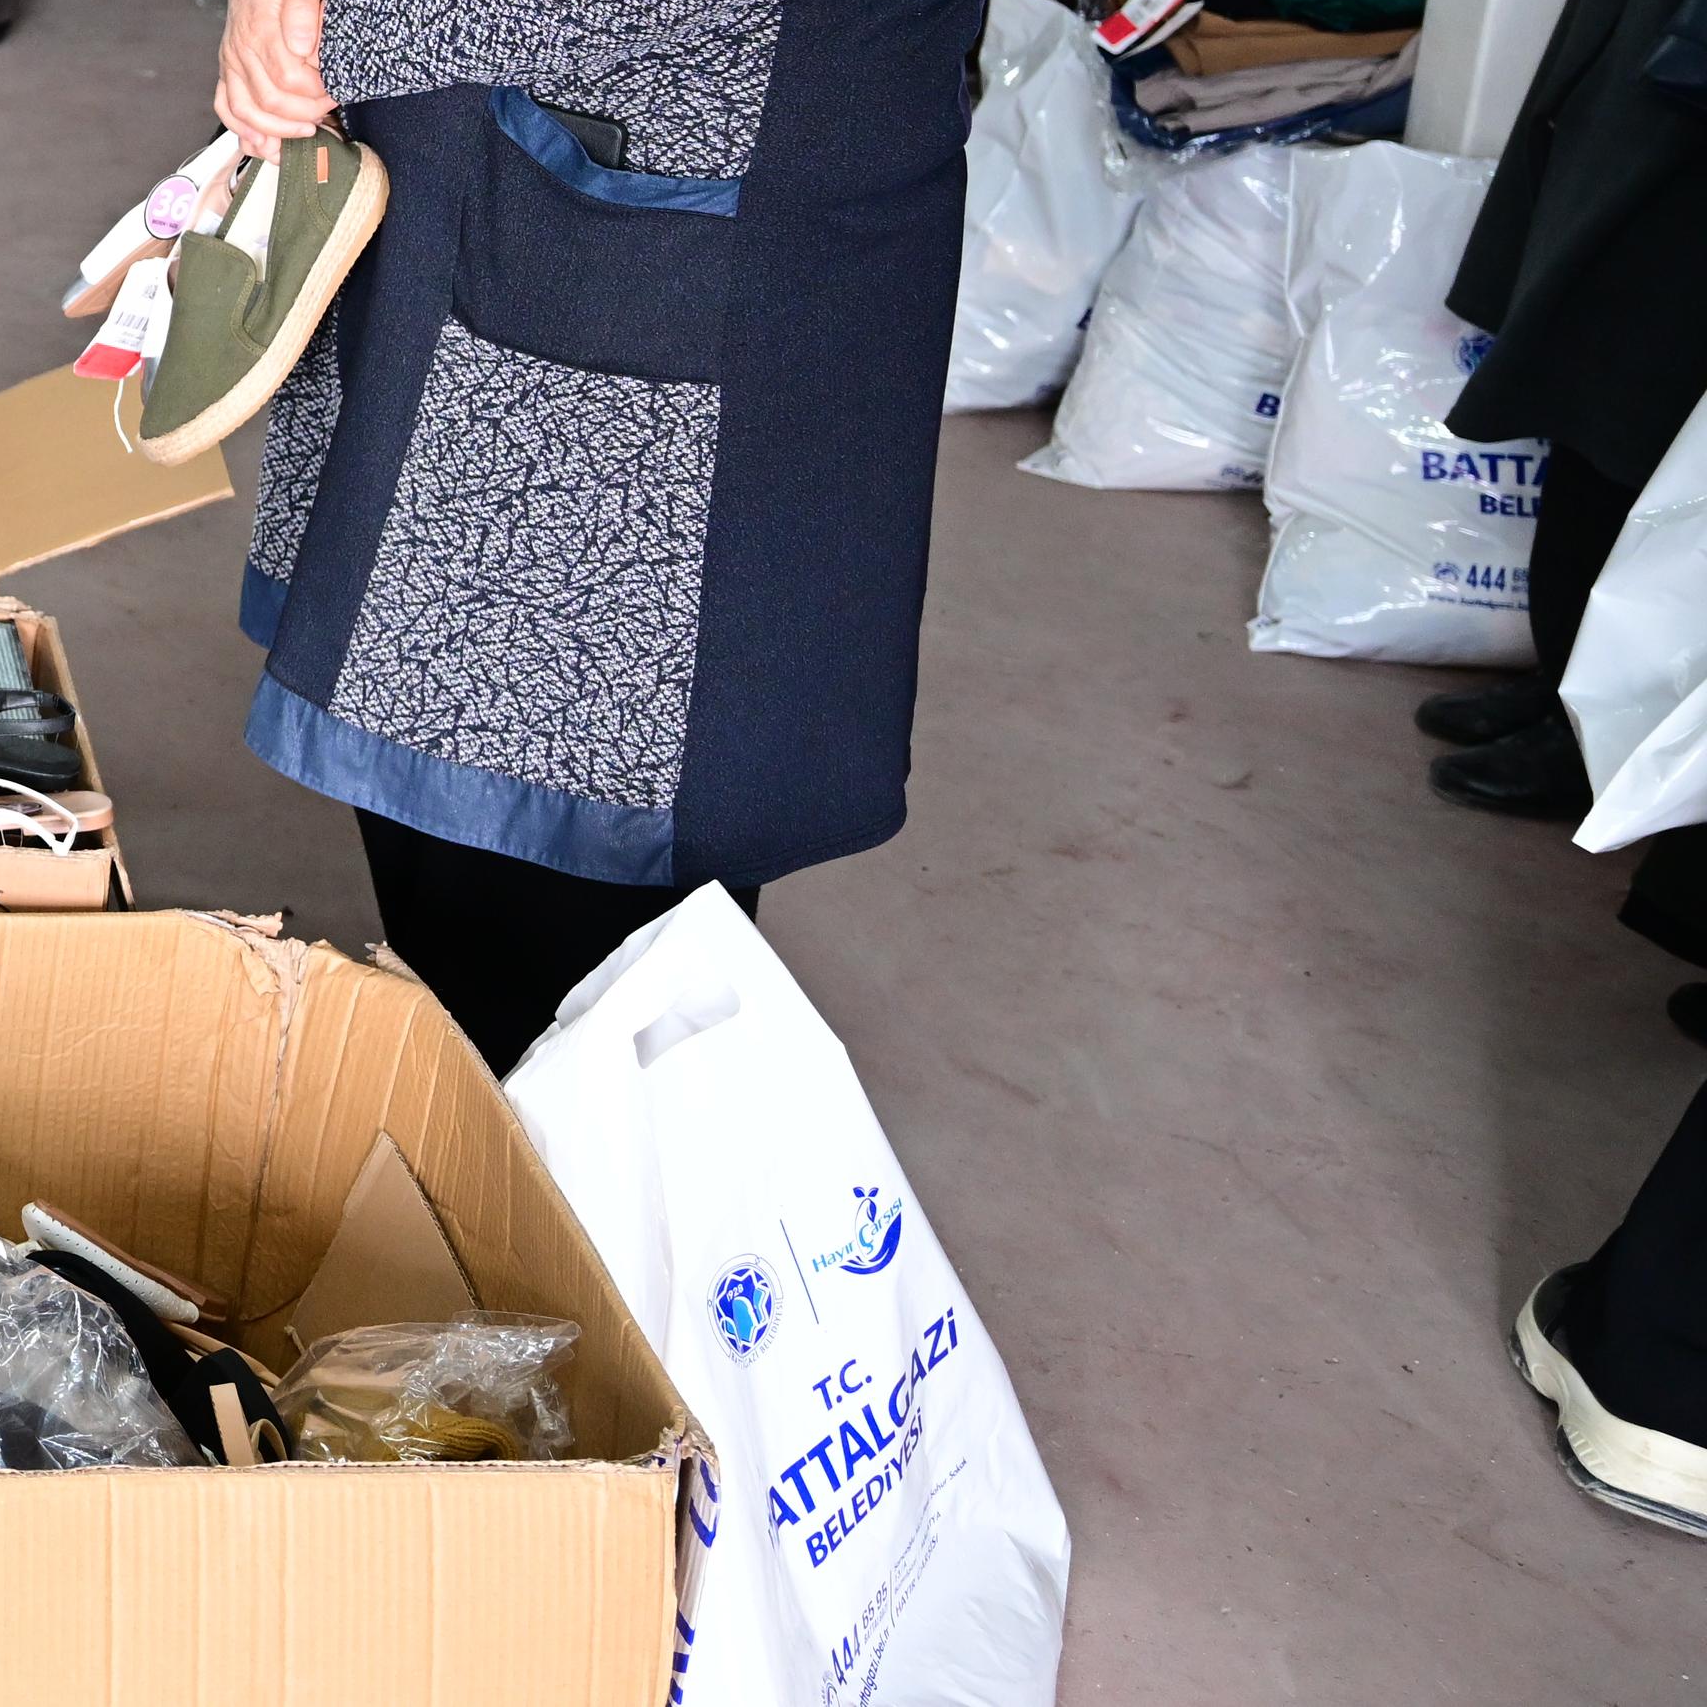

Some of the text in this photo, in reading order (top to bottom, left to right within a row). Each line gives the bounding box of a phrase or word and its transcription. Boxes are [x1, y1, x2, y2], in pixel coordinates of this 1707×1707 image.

[152, 188, 193, 221] 36
[1466, 563, 1506, 591] 444
[727, 1283, 744, 1302] 1928
[812, 1358, 873, 1411] T.C.
[831, 1622, 861, 1686] 444
